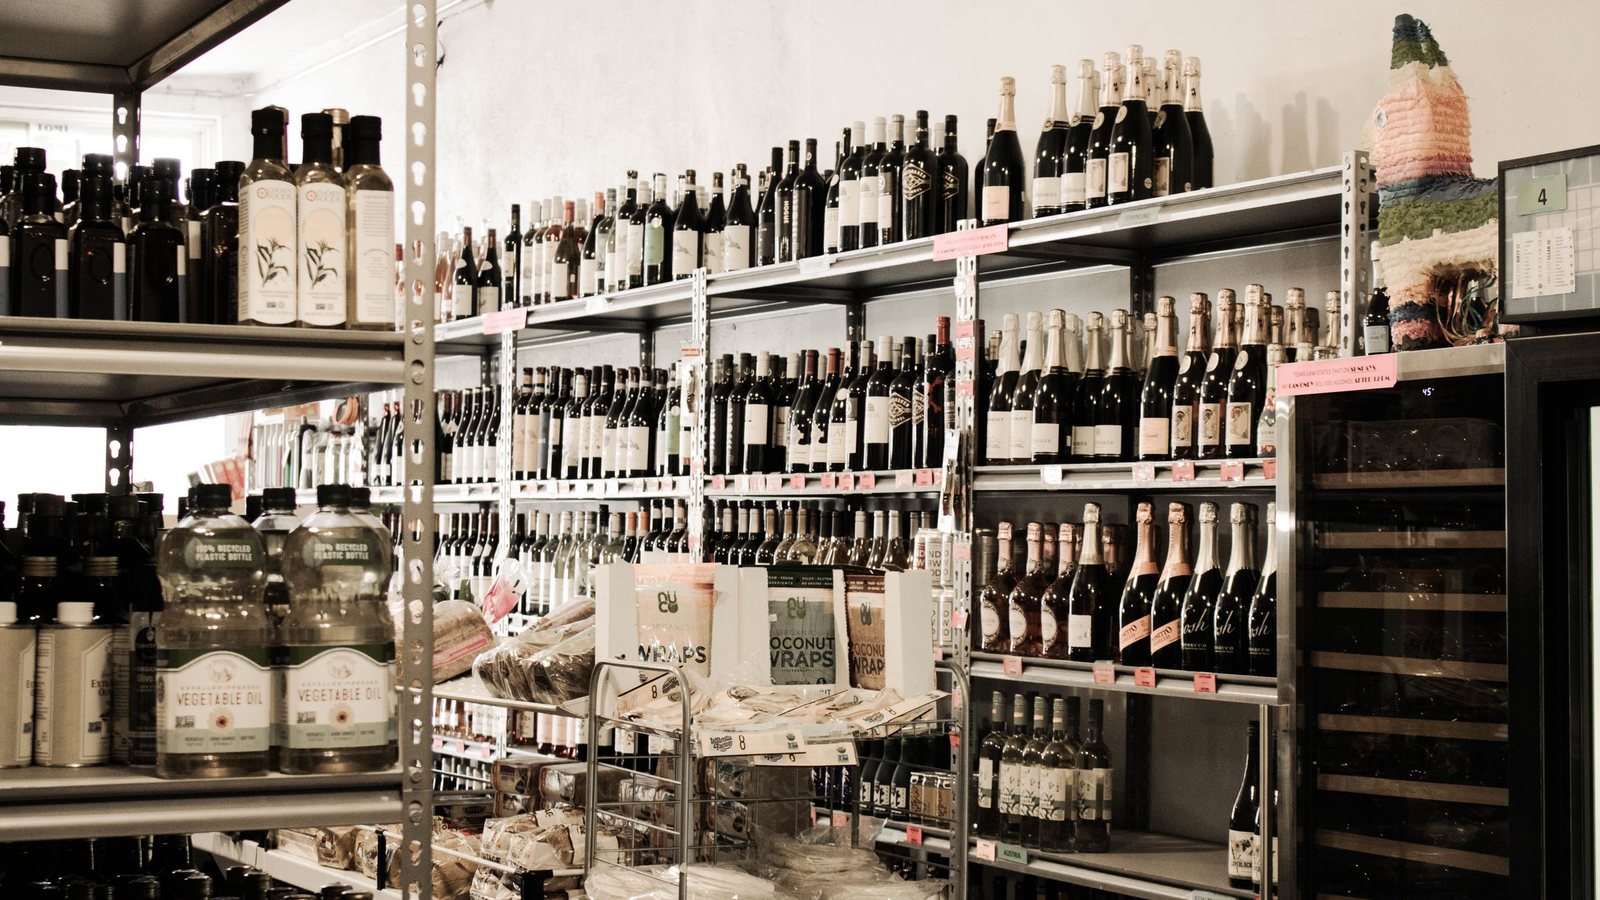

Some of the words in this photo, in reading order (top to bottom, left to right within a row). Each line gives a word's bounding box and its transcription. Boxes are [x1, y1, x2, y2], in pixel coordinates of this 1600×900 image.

[1537, 188, 1548, 206] 4
[217, 545, 251, 553] RECYCLED
[335, 544, 368, 552] RECYCLED
[196, 553, 226, 561] PLASTIC
[228, 553, 252, 561] BOTTLE
[314, 552, 344, 560] PLASTIC
[346, 552, 369, 560] BOTTLE
[770, 637, 835, 650] OCONUT
[853, 657, 885, 675] WRAP
[177, 692, 242, 706] VEGETABLE
[247, 691, 263, 705] OIL
[298, 687, 361, 702] VEGETABLE
[366, 686, 382, 700] OIL
[651, 684, 658, 699] 8
[738, 734, 746, 751] 8
